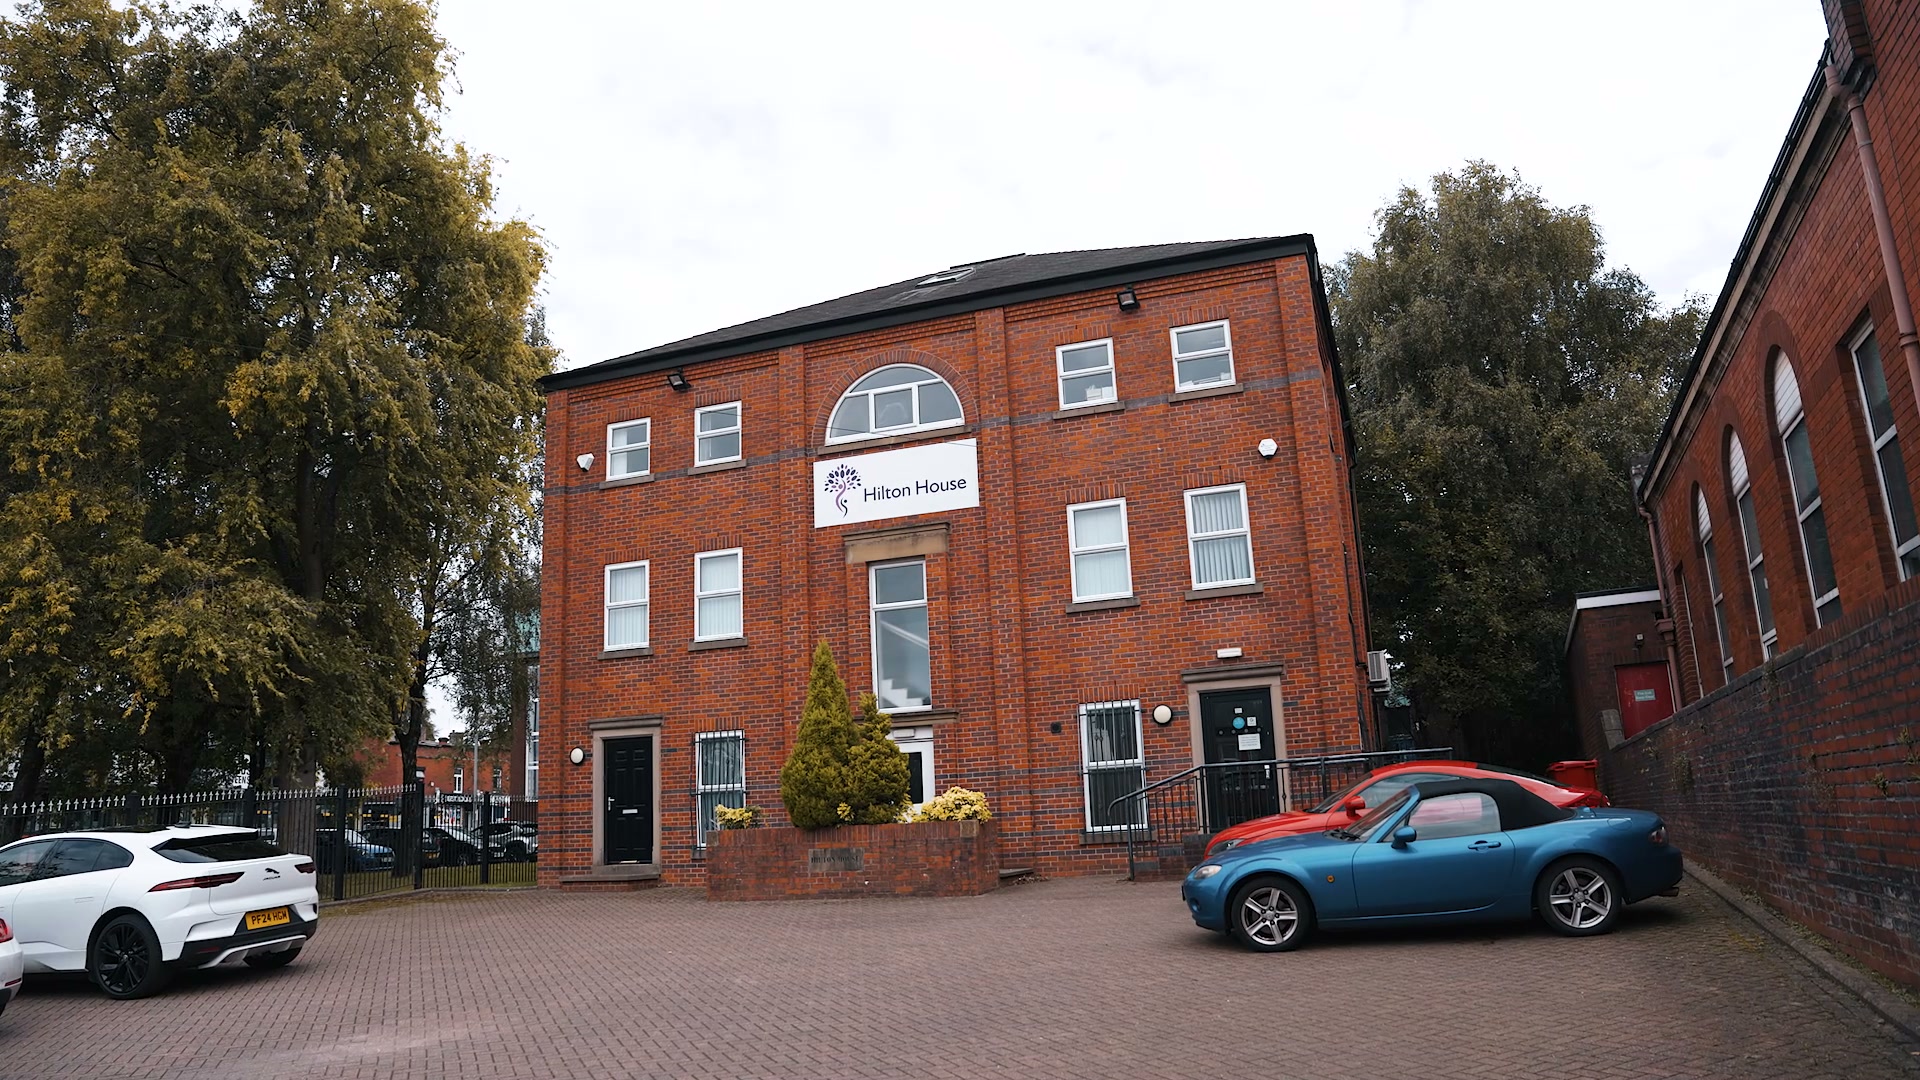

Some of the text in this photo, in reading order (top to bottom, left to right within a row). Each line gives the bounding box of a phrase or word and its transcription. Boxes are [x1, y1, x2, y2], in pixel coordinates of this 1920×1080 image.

[864, 478, 967, 502] Hilton House
[251, 913, 271, 925] PF24
